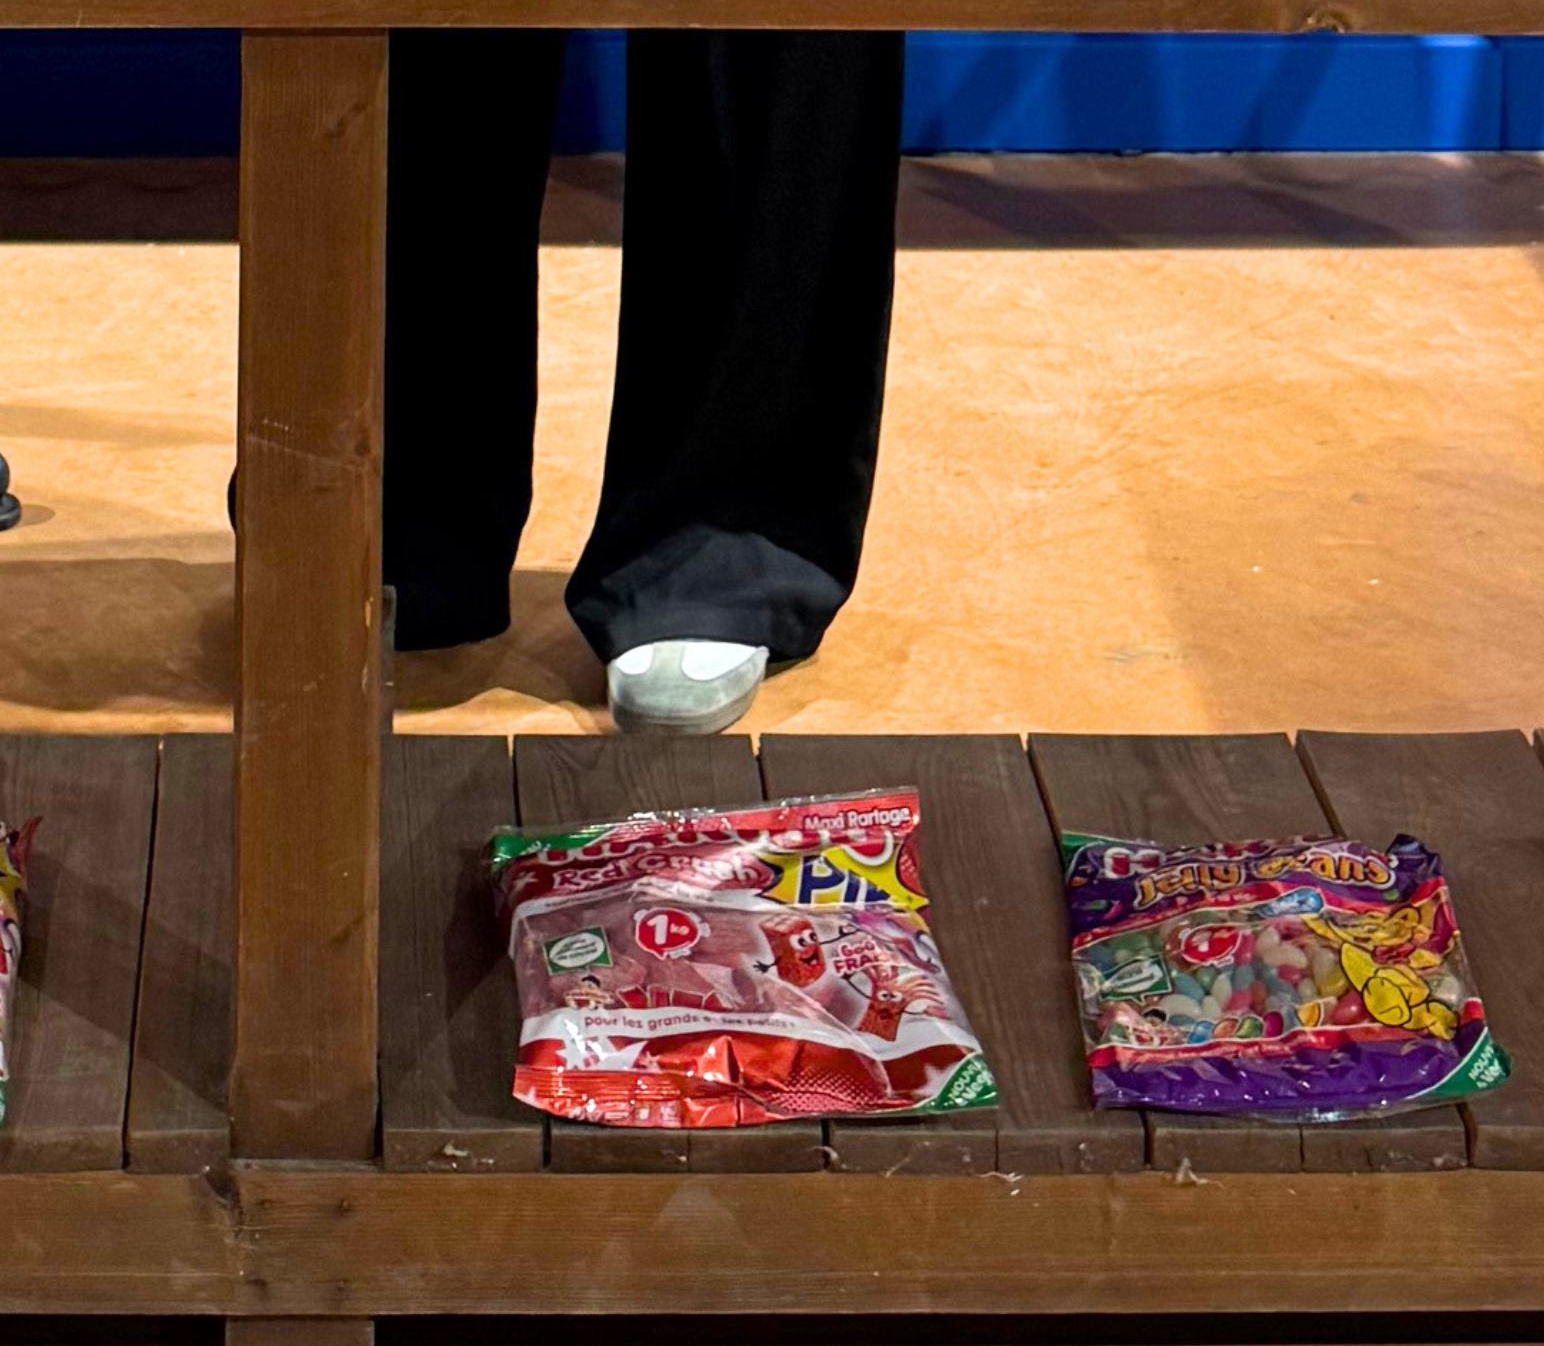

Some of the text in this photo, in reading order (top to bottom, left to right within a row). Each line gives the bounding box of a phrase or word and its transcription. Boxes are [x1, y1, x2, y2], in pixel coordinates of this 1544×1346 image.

[804, 807, 910, 831] Maxi Partage
[647, 914, 669, 945] 1
[584, 1016, 618, 1030] pour
[623, 1016, 643, 1029] les
[648, 1014, 698, 1031] grands
